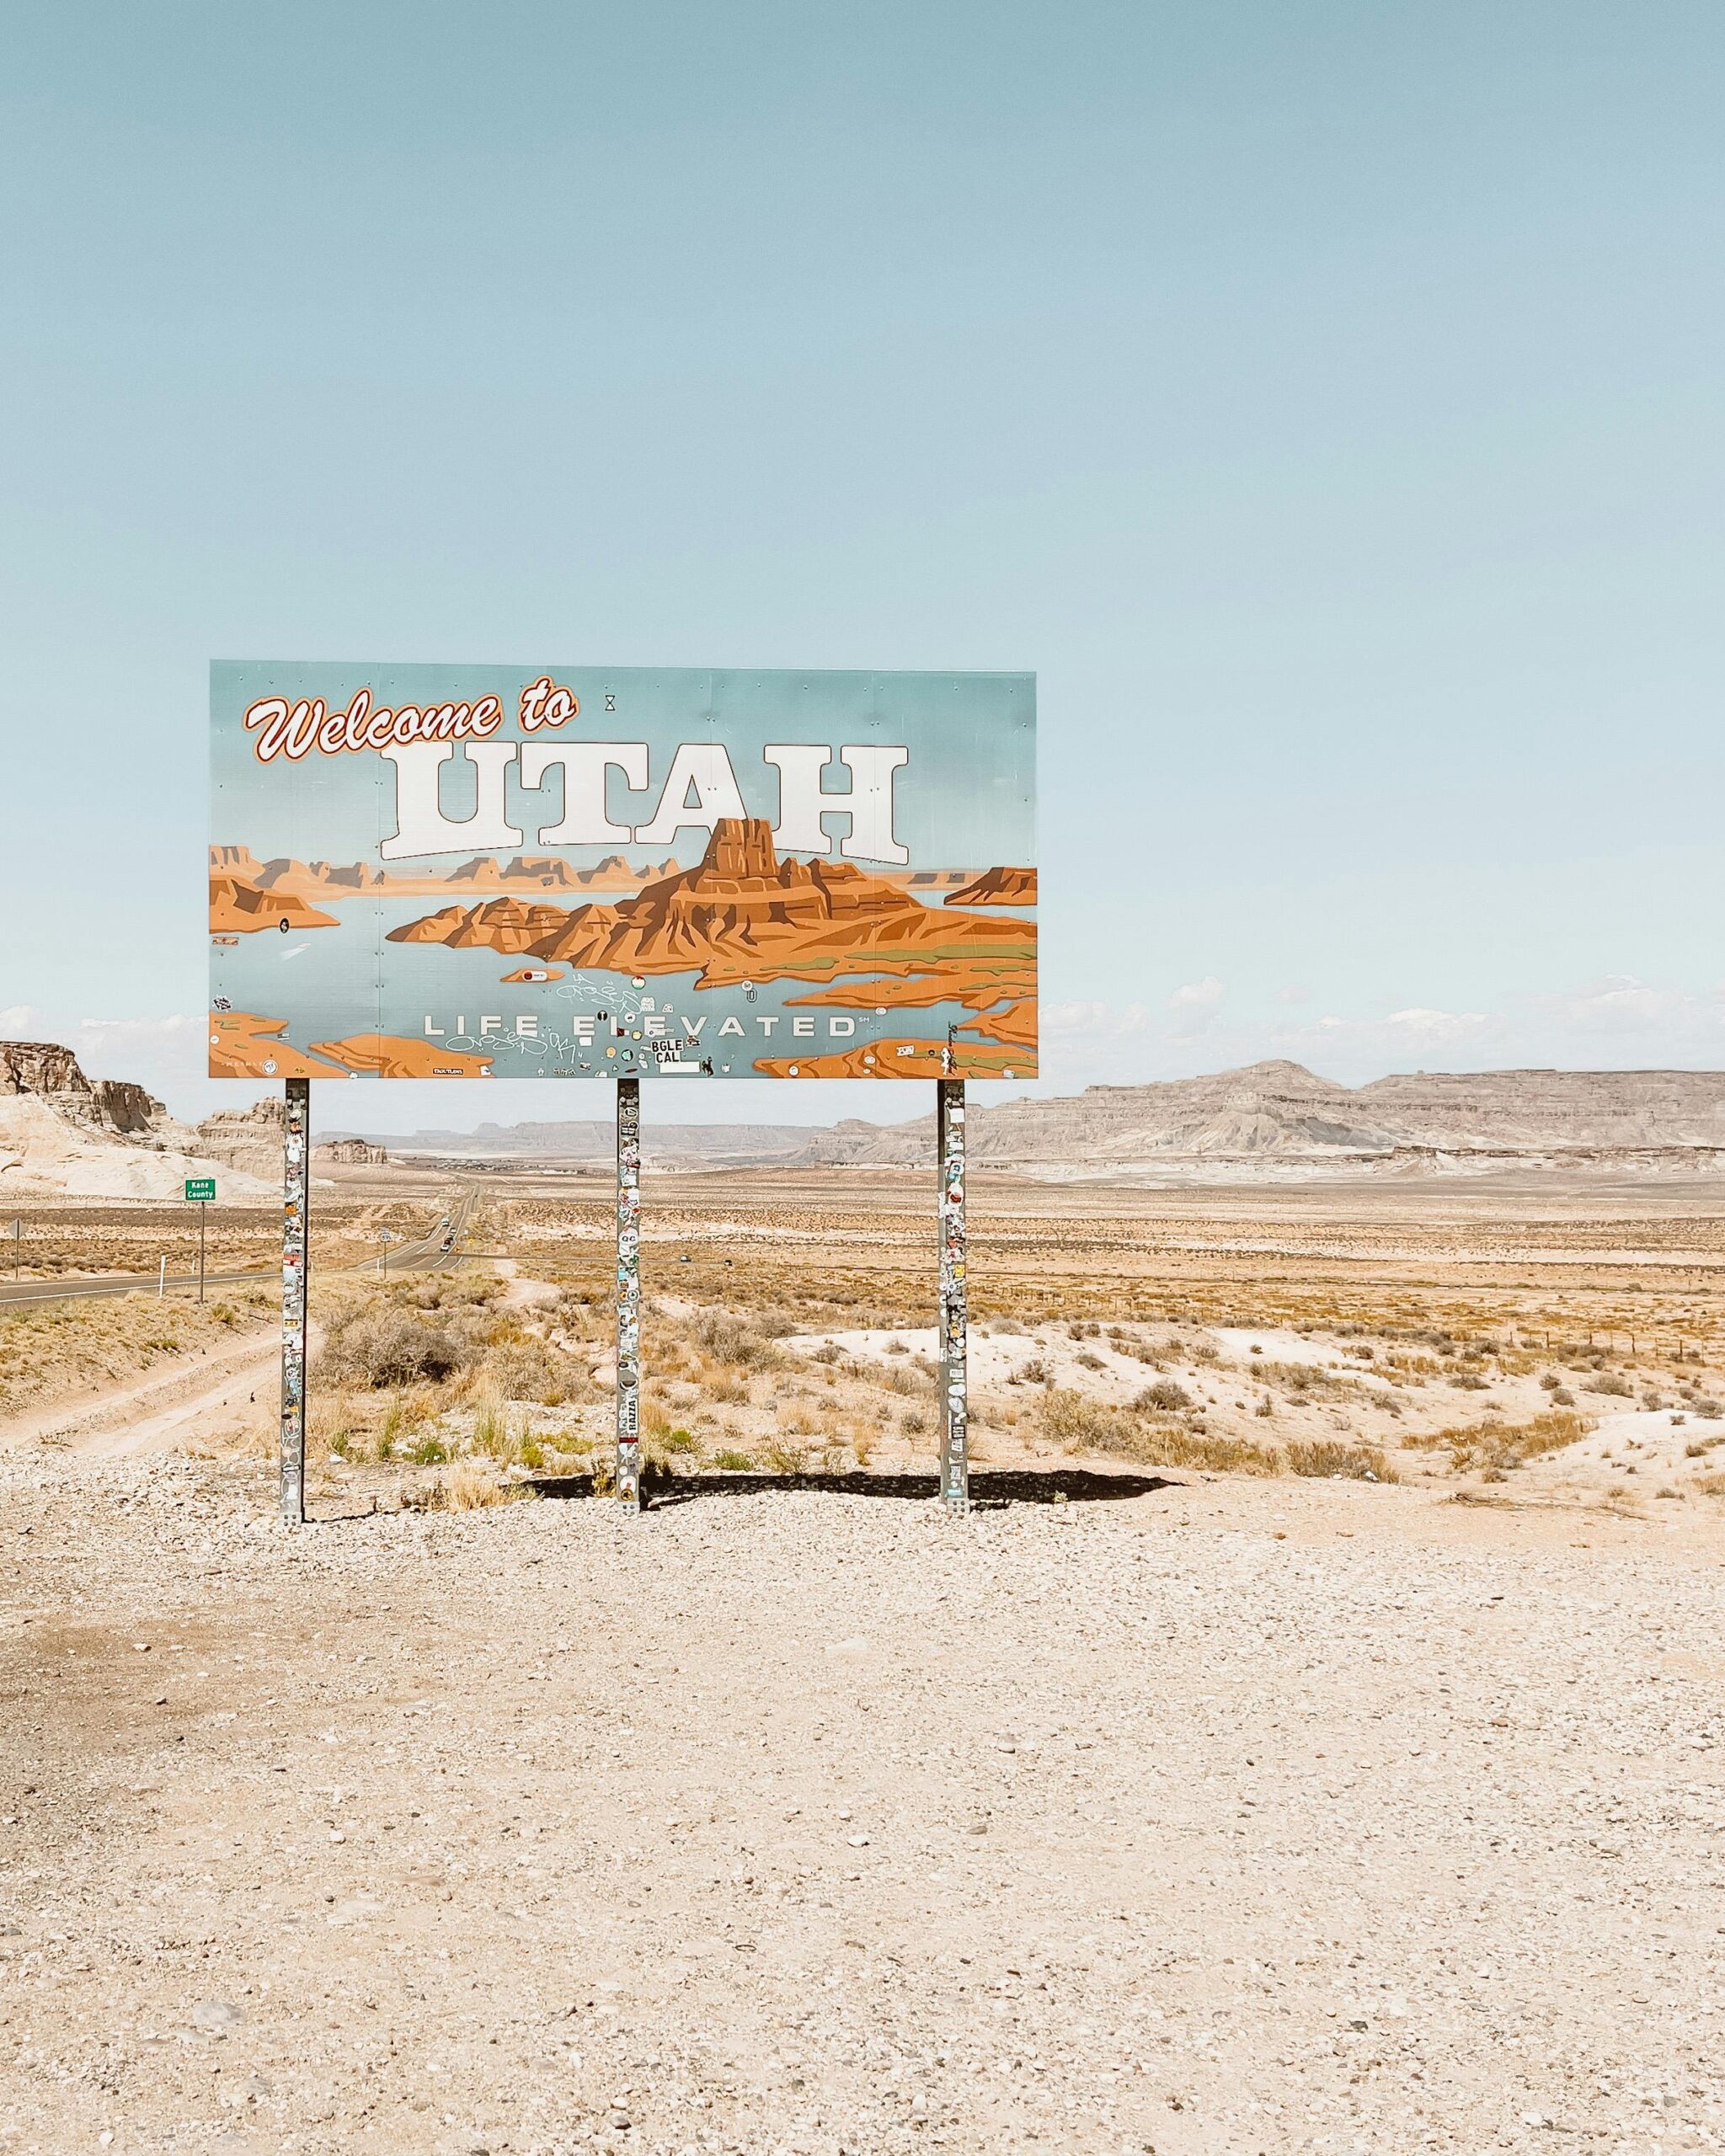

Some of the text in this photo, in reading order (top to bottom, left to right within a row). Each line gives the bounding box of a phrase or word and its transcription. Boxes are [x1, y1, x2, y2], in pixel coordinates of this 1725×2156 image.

[243, 676, 579, 763] Welcome to
[381, 741, 909, 866] UTAH
[424, 1015, 538, 1038] LIFE
[651, 1039, 683, 1053] BGLE
[656, 1051, 680, 1063] CAL
